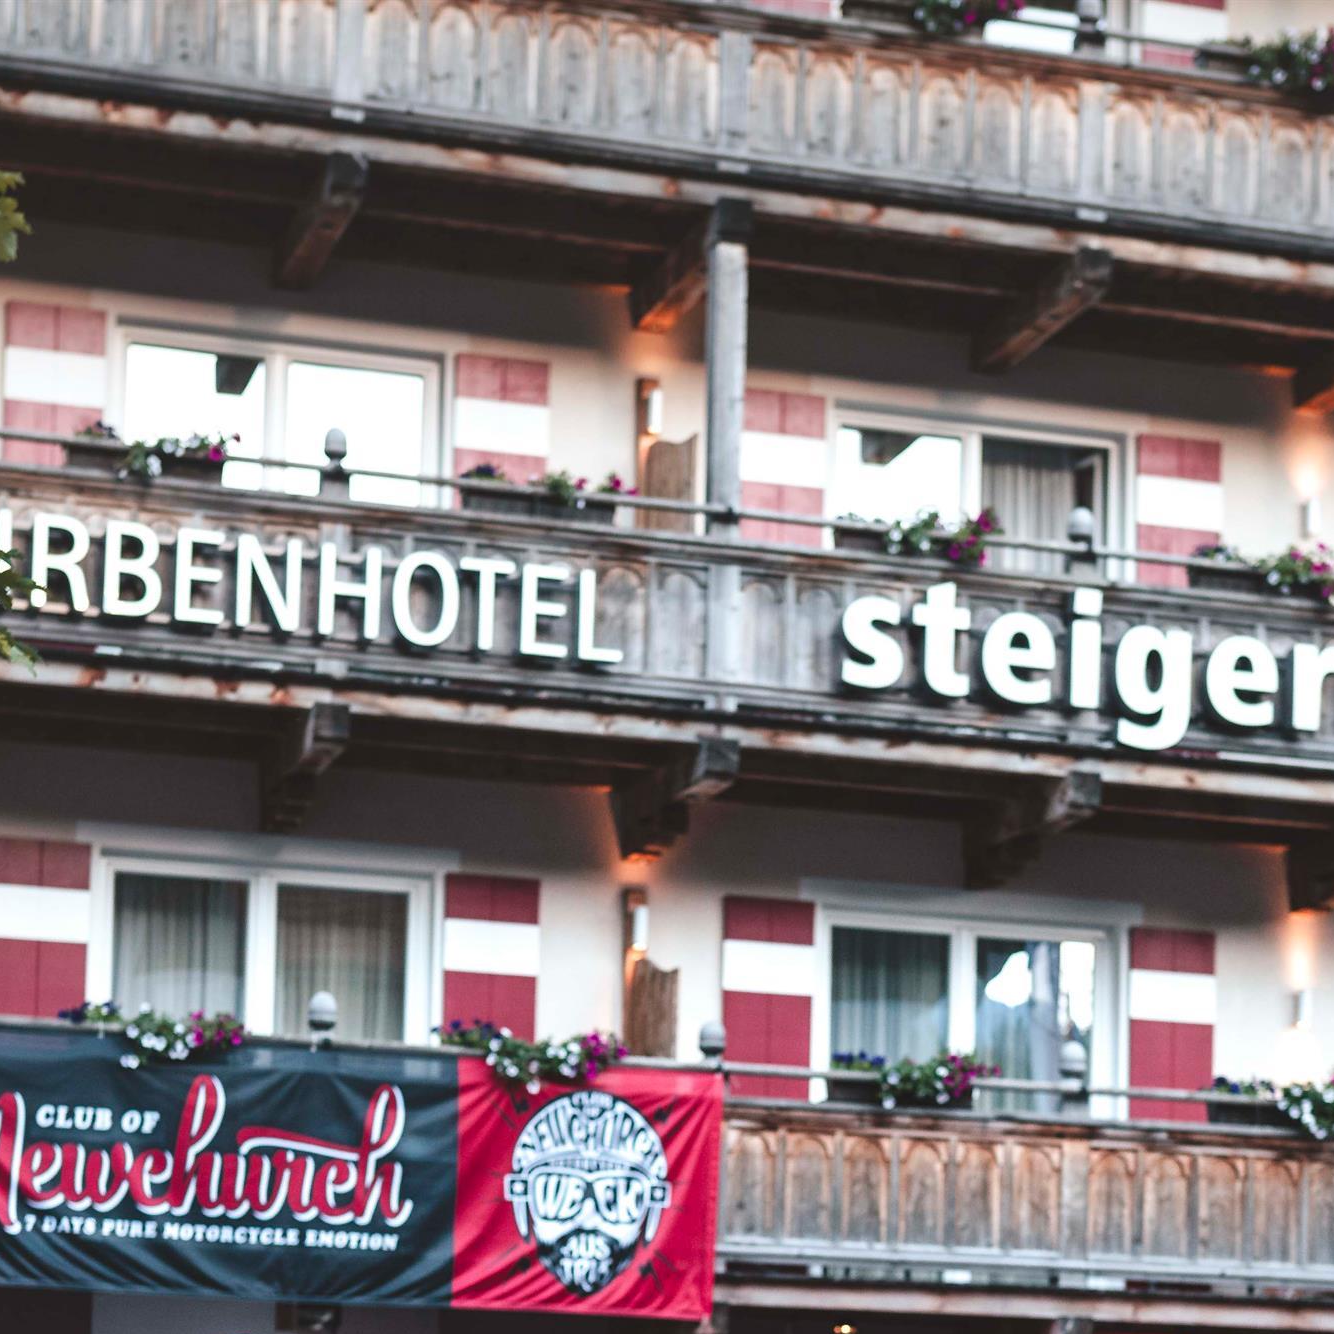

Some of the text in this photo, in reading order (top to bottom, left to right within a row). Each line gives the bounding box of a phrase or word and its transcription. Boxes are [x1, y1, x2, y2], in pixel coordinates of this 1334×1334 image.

[35, 1104, 161, 1134] CLUB OF
[23, 1213, 399, 1252] 7 DAYS PURE MOTORCYCLE EMOTION
